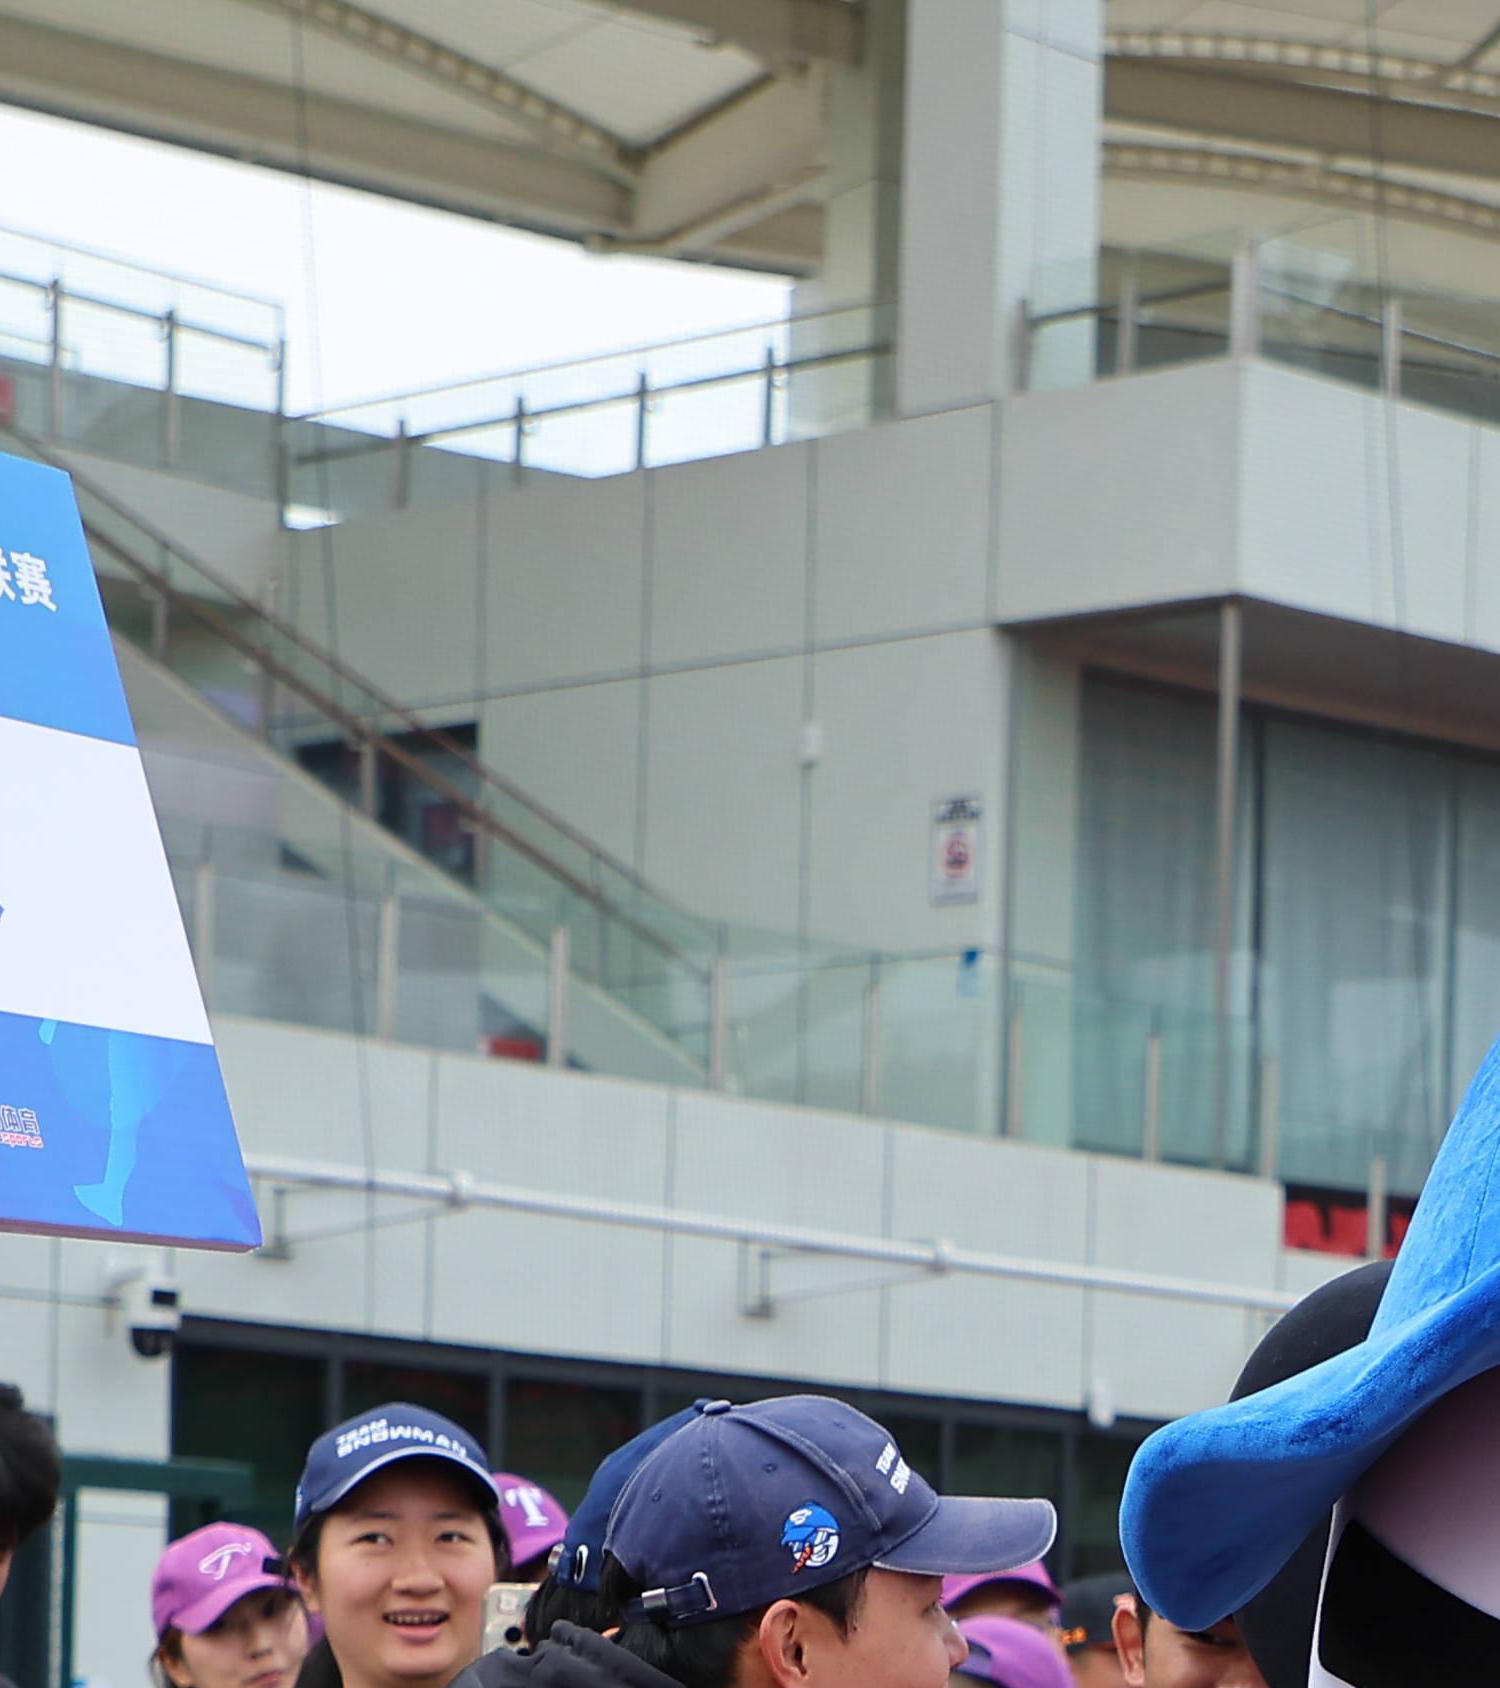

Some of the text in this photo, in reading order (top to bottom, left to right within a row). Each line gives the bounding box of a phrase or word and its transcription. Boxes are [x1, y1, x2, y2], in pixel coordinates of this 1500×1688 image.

[335, 1418, 388, 1447] TEAM
[337, 1425, 468, 1459] SNOWMAN
[504, 1486, 549, 1527] T
